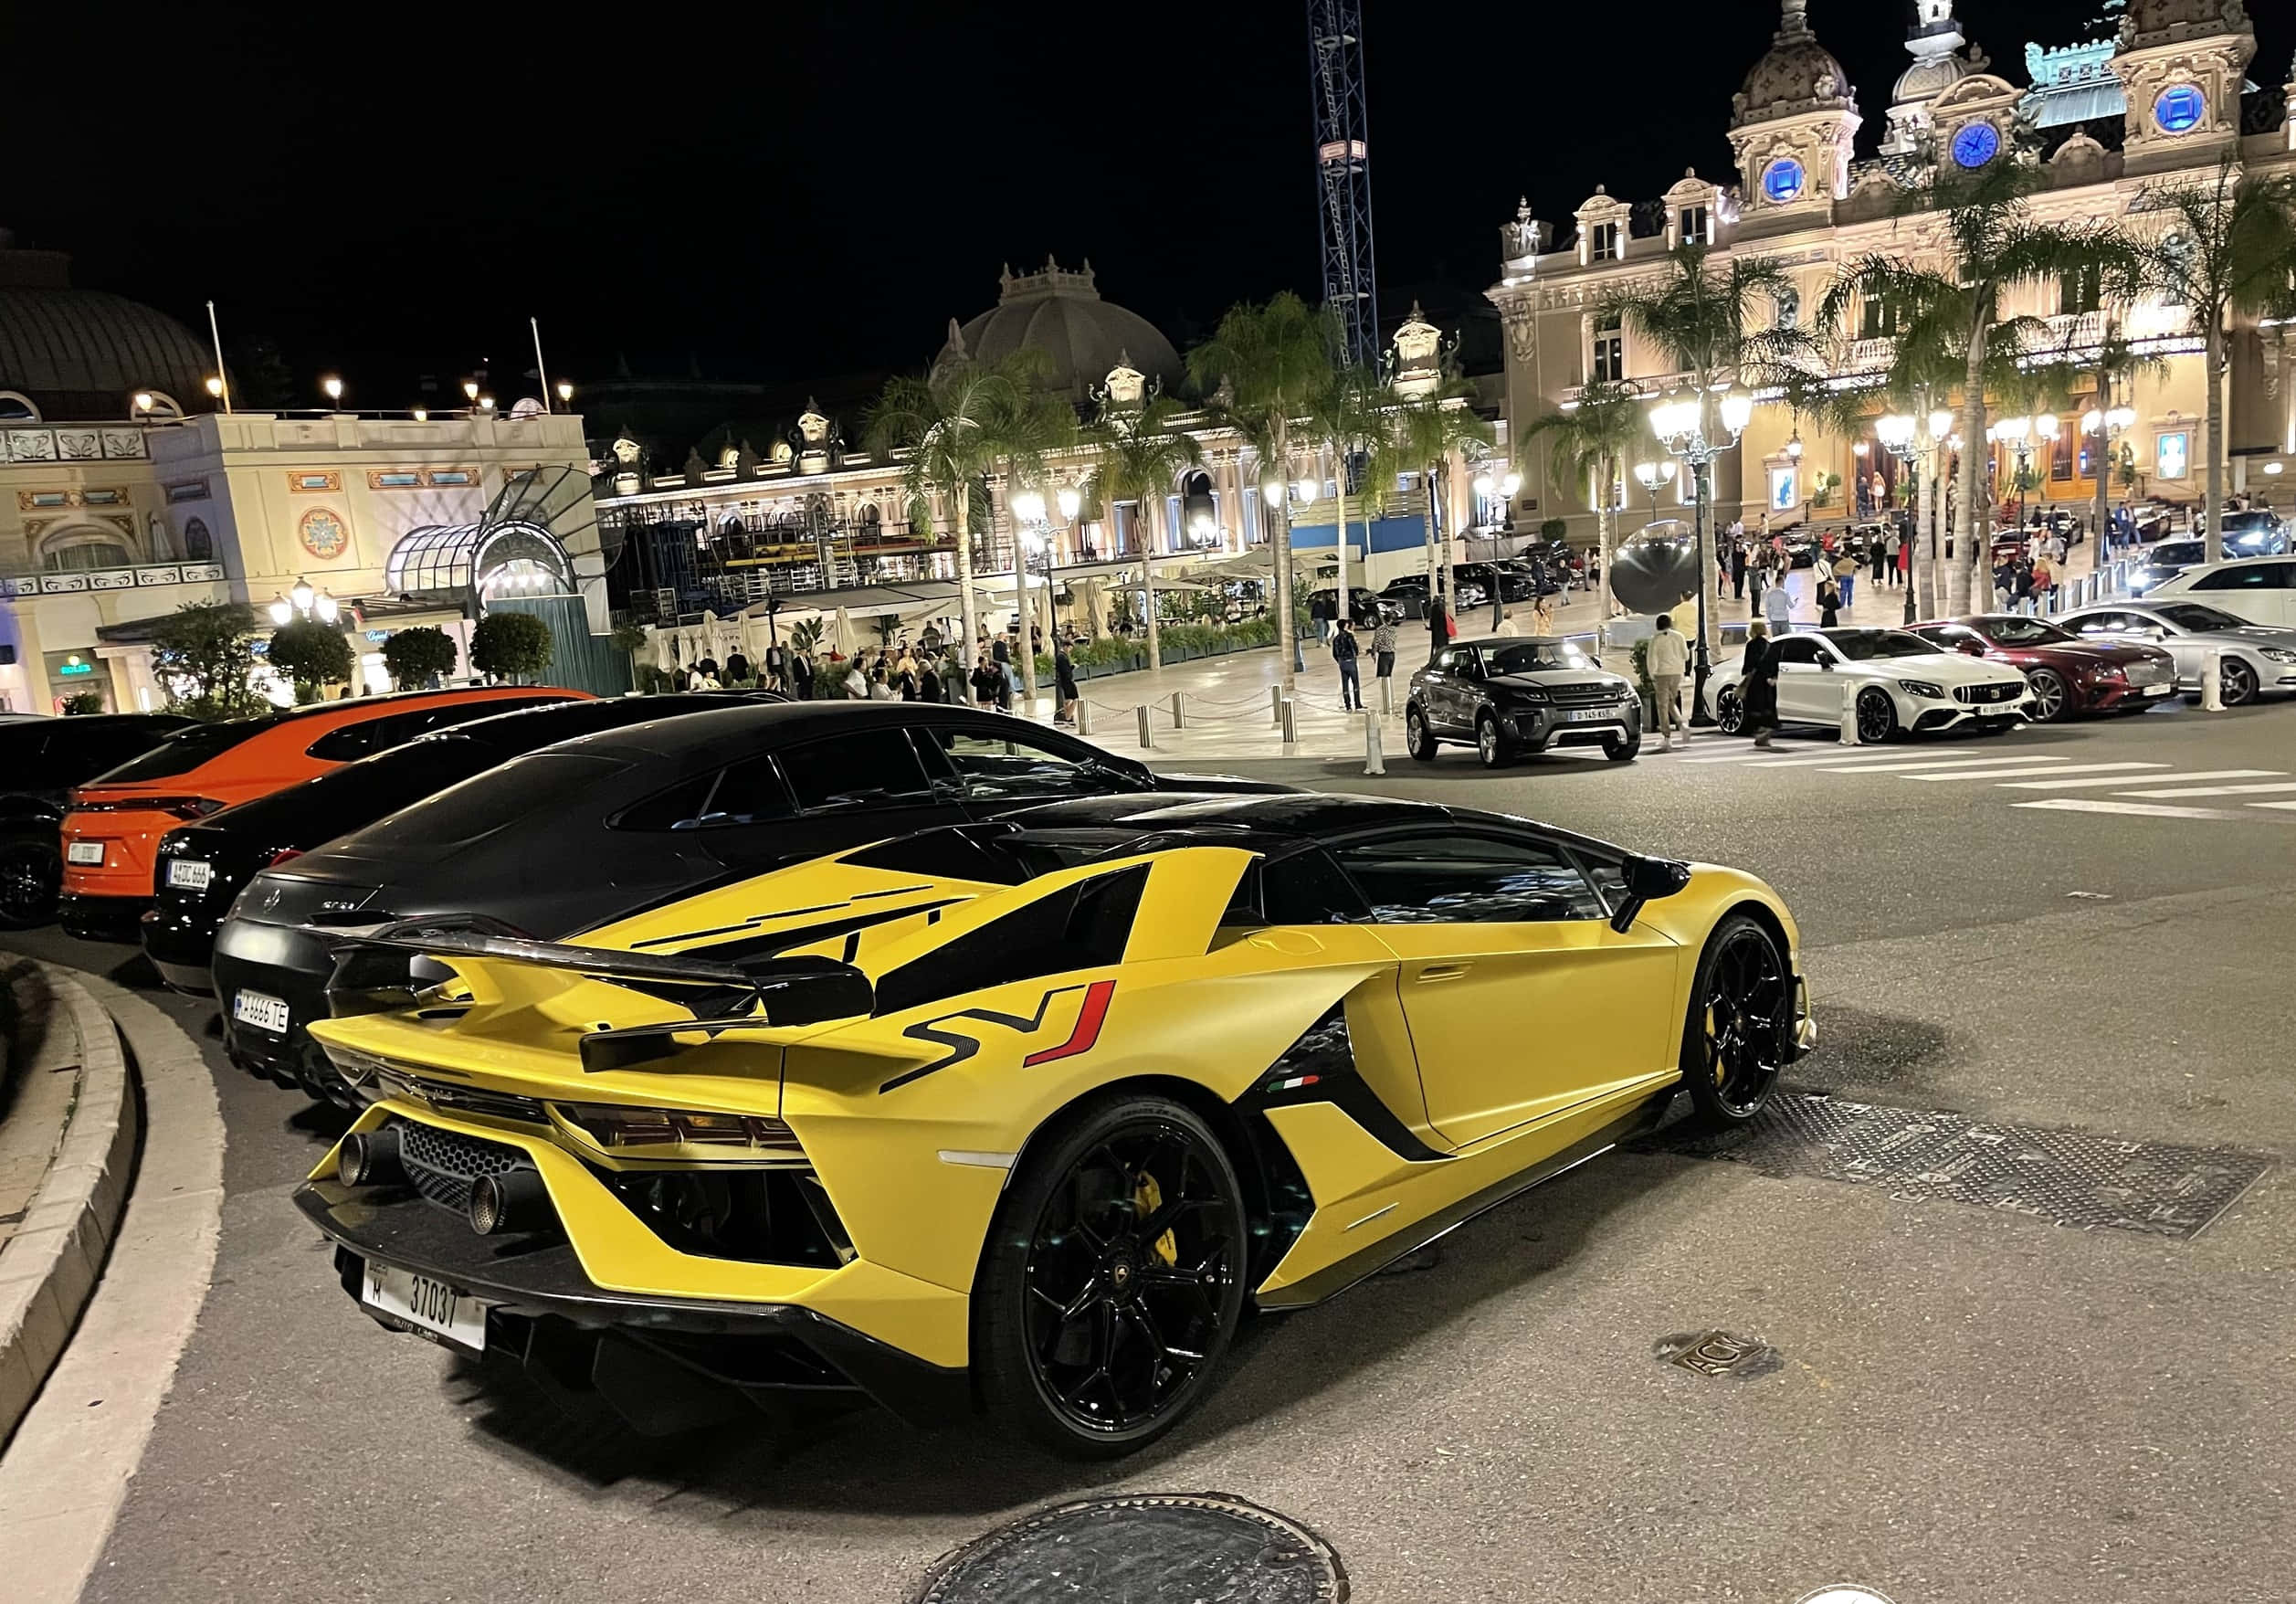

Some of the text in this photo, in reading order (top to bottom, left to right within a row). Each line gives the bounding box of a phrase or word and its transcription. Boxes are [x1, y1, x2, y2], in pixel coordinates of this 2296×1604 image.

[879, 980, 1117, 1094] SVJ
[373, 1275, 457, 1328] M 37037
